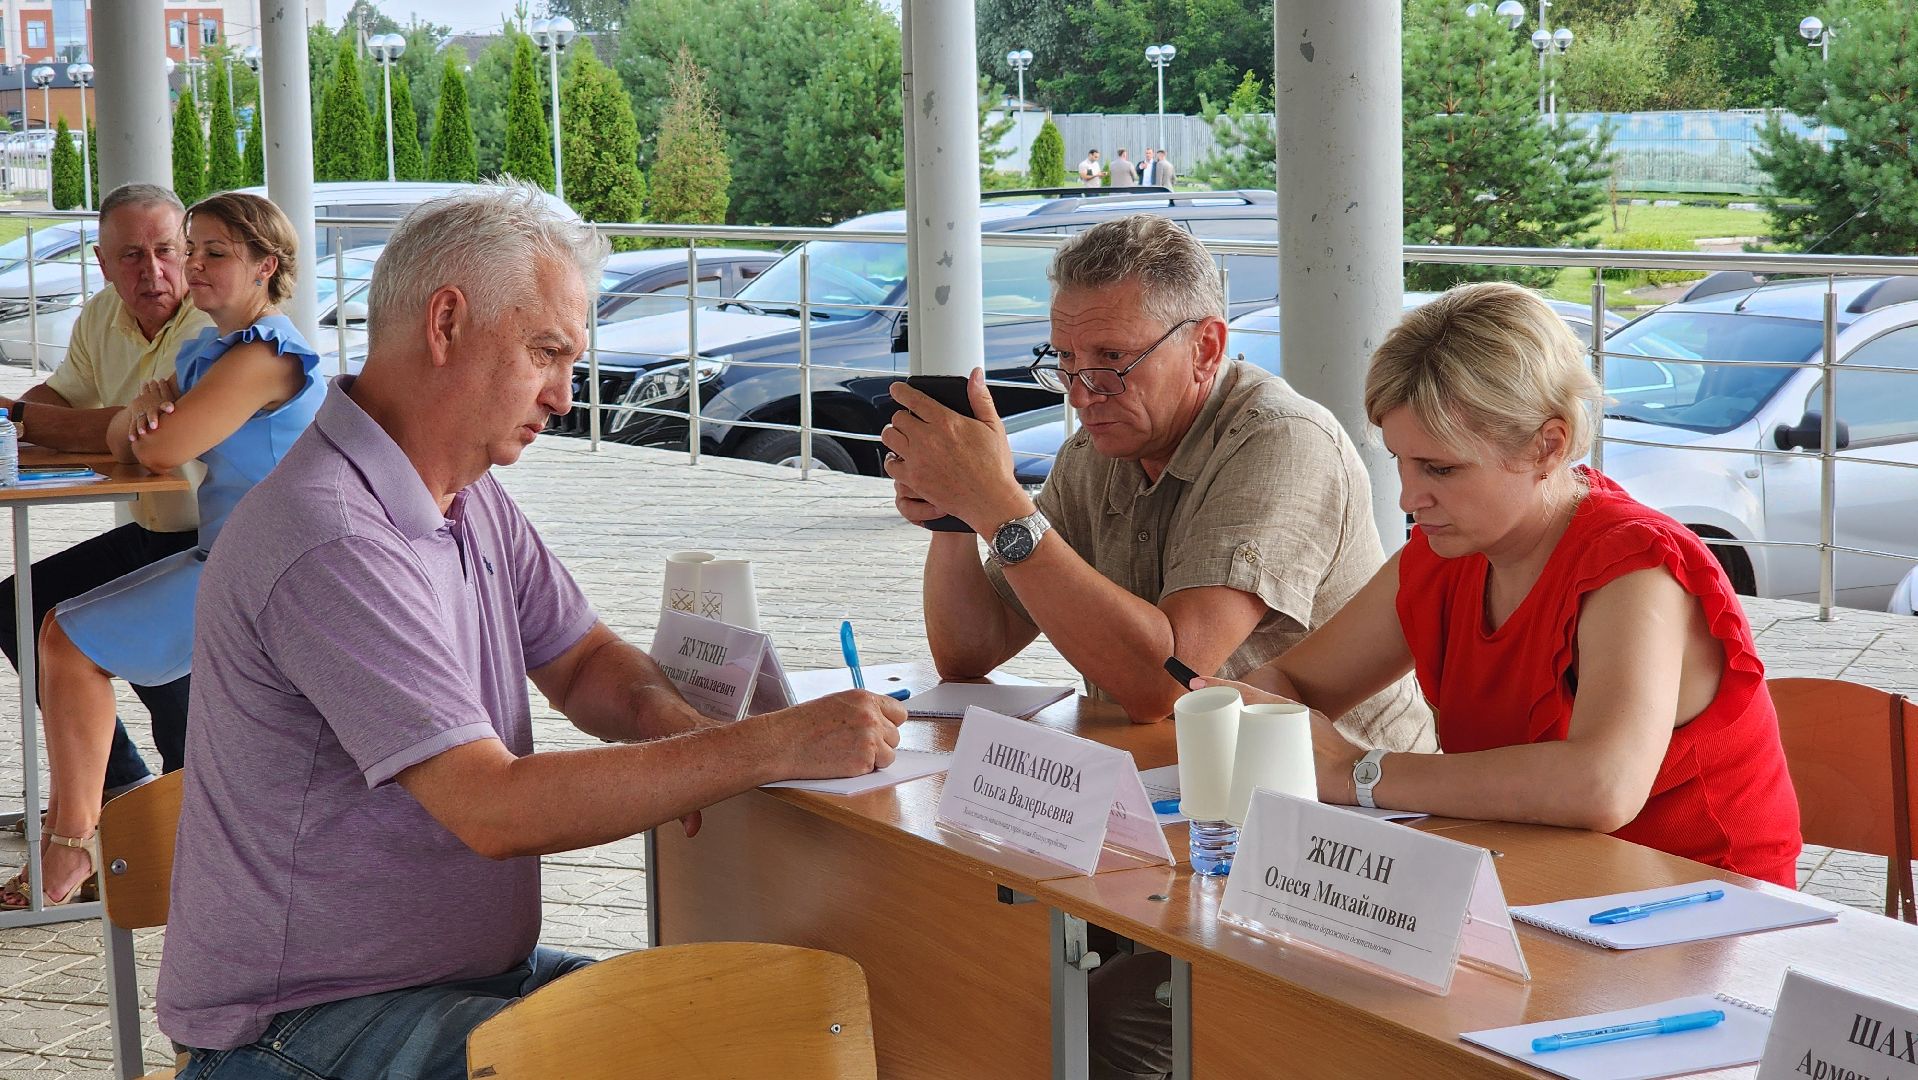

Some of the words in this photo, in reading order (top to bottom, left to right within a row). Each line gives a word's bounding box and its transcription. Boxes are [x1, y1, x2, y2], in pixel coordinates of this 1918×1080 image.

[678, 636, 729, 666] ЖУТКИН
[688, 669, 737, 697] Николаевич
[982, 741, 1083, 793] АНИКАНОВА
[973, 774, 1007, 802] Ольга
[1007, 786, 1075, 825] Валерьевна
[1306, 835, 1396, 885] ЖИГАН
[1265, 865, 1311, 899] Олеся
[1313, 879, 1418, 933] Михайловна
[1847, 1013, 1918, 1066] ШАХ
